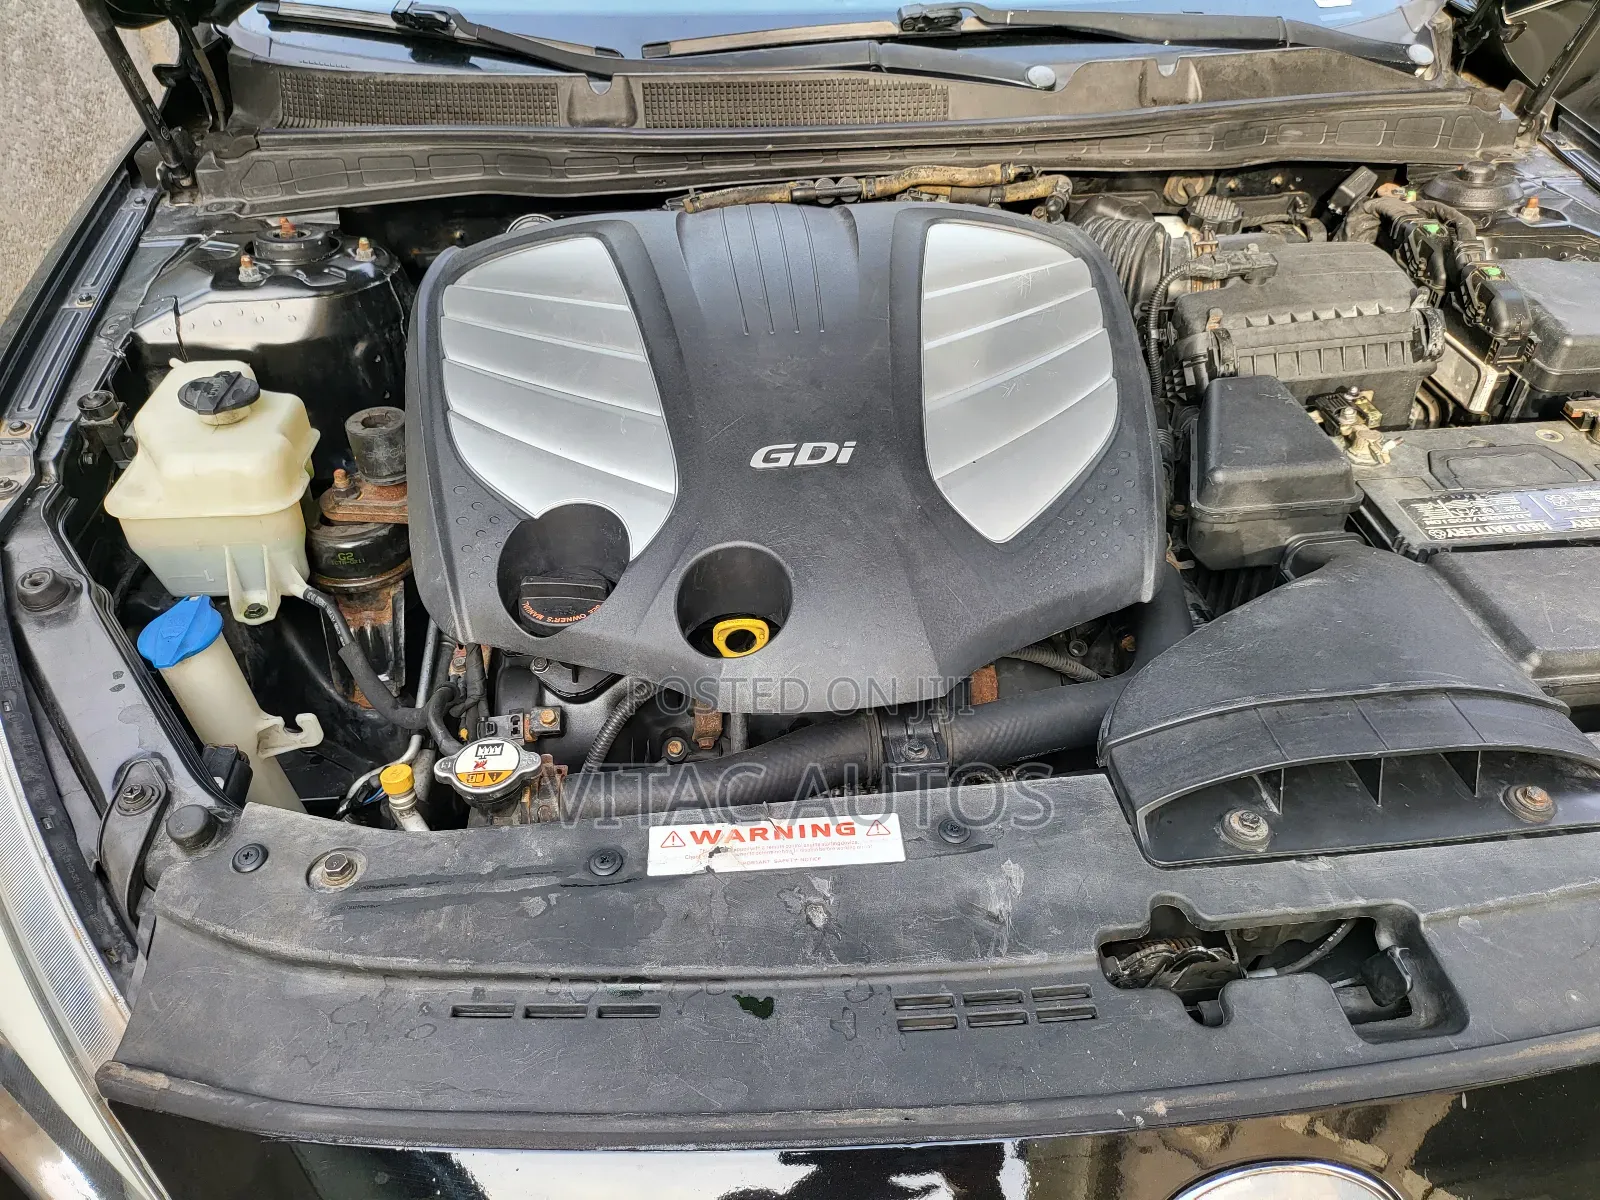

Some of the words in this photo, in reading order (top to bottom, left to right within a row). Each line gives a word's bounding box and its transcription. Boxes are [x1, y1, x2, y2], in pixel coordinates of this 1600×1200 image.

[750, 441, 857, 469] GDi
[1447, 524, 1516, 538] BATTERY
[522, 601, 544, 620] MANUAL
[546, 613, 587, 623] OWNER'S
[690, 822, 856, 845] WARNING
